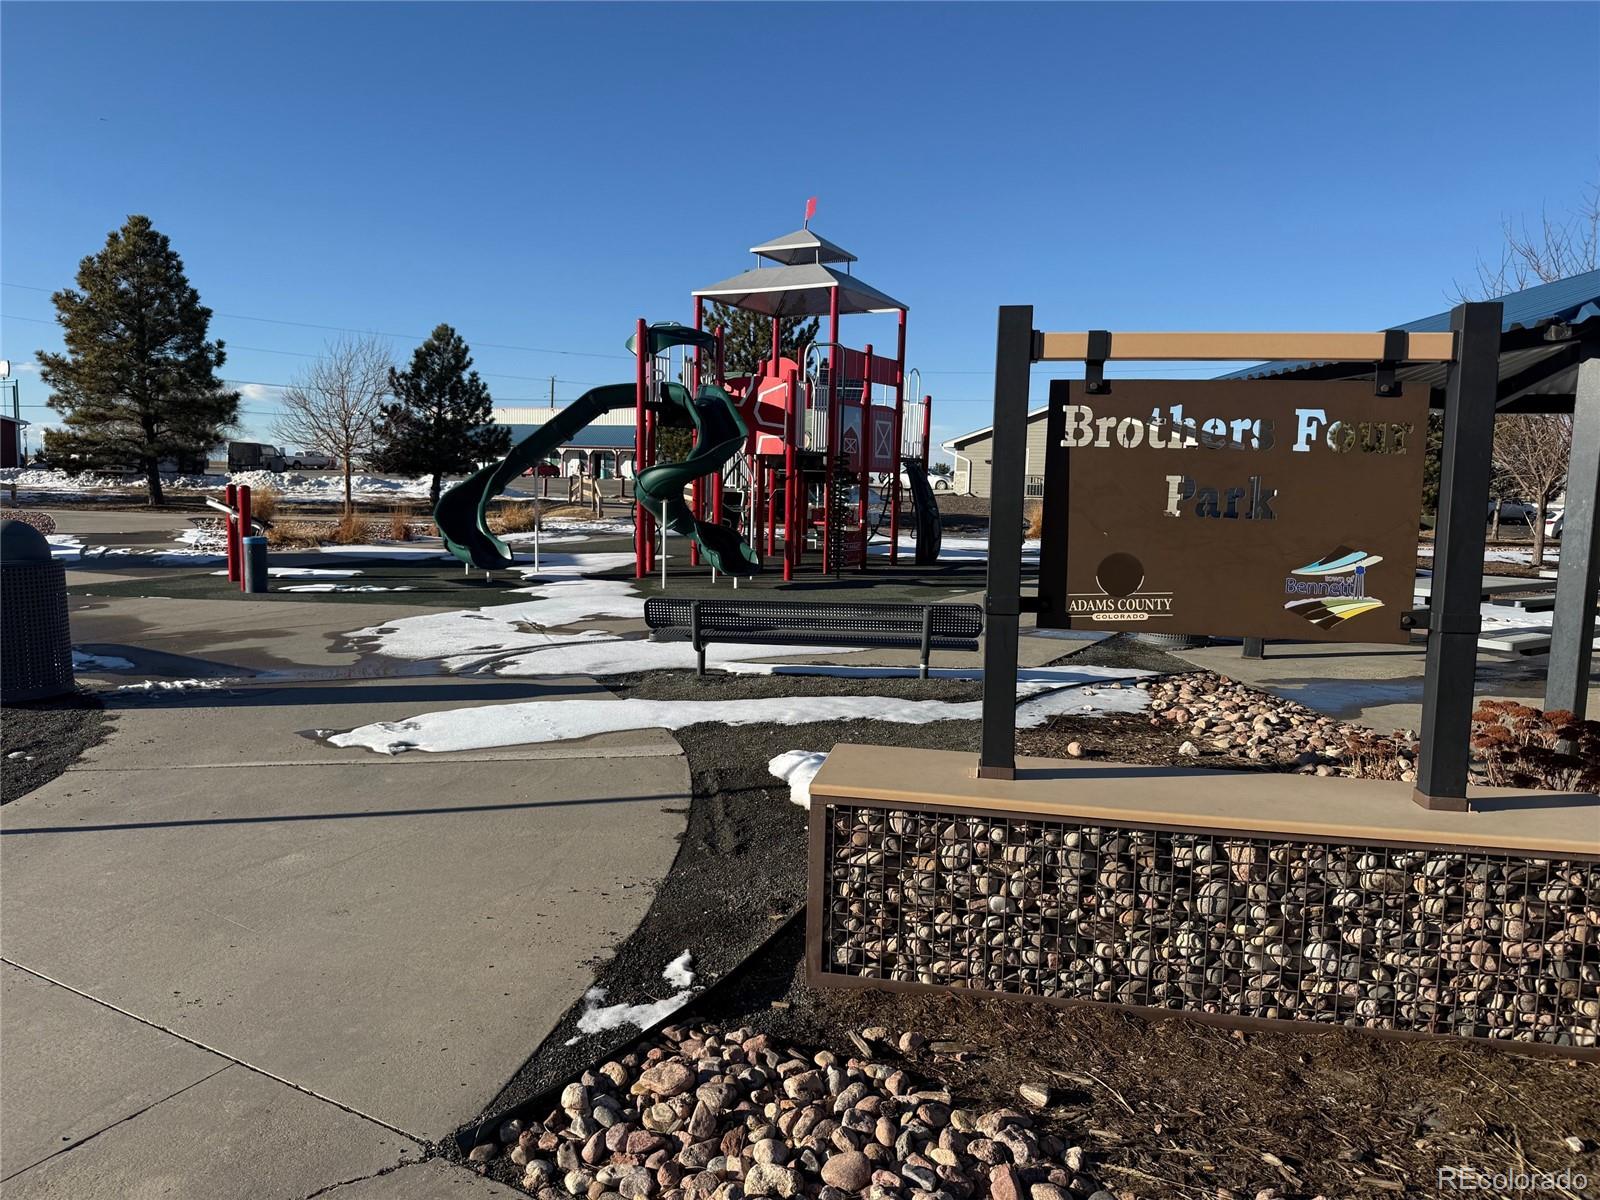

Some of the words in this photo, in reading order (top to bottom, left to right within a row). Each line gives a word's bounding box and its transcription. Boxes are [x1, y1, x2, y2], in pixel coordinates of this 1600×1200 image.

[1060, 404, 1275, 451] Brothers
[1292, 408, 1414, 455] Four
[1163, 474, 1279, 520] Park
[1285, 577, 1355, 596] Bennett
[1069, 599, 1115, 611] ADAMS
[1117, 598, 1173, 611] COUNTY
